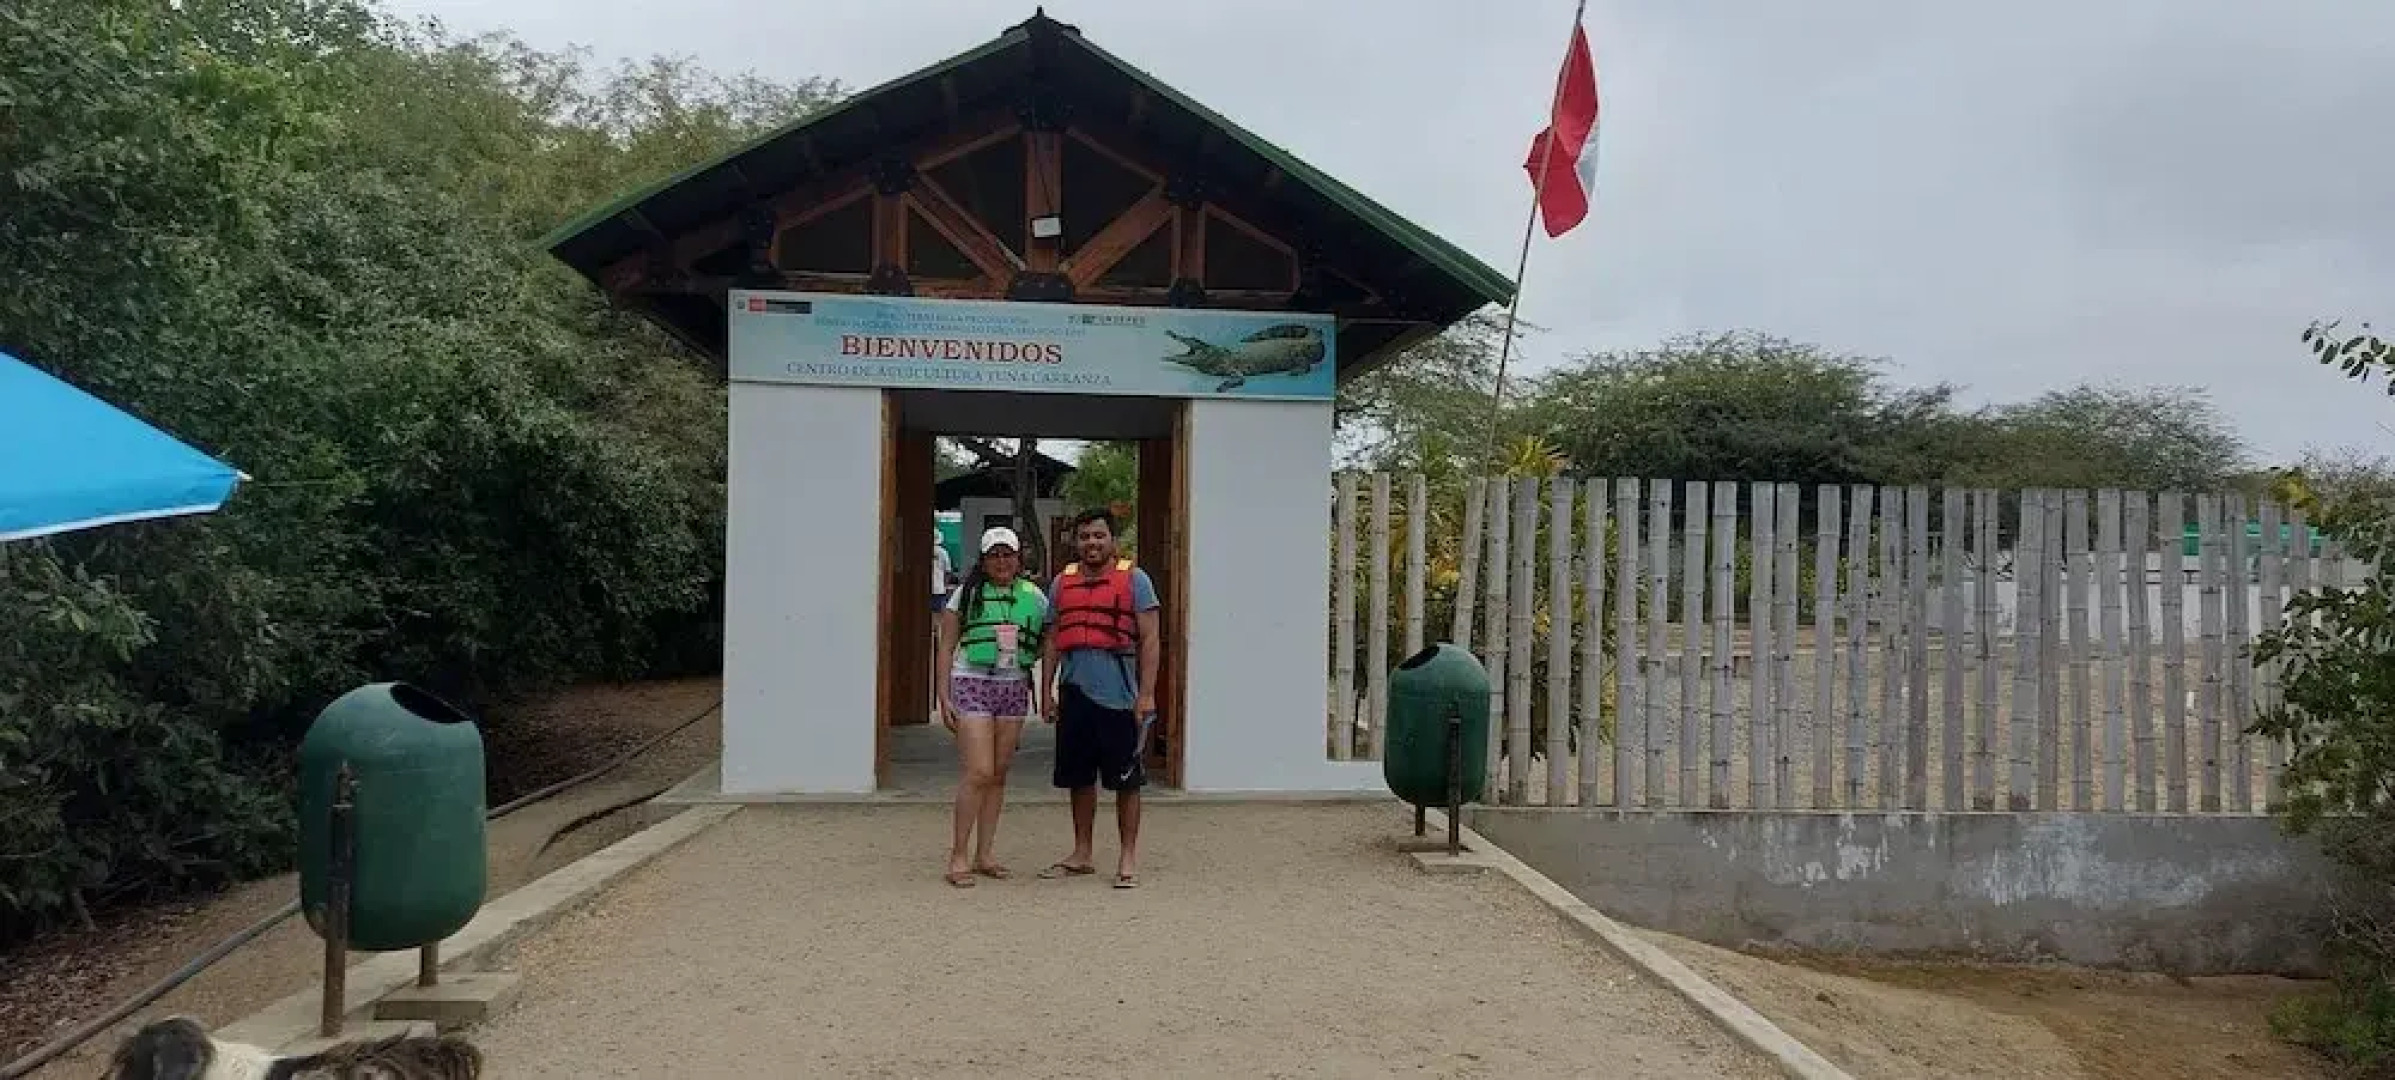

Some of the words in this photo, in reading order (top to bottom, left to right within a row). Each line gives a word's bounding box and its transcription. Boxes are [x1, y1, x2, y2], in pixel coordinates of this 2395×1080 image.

[842, 335, 1061, 364] BIENVENIDOS
[786, 362, 849, 376] CENTRO
[851, 365, 868, 377] DE
[1031, 371, 1112, 385] CARRANZA
